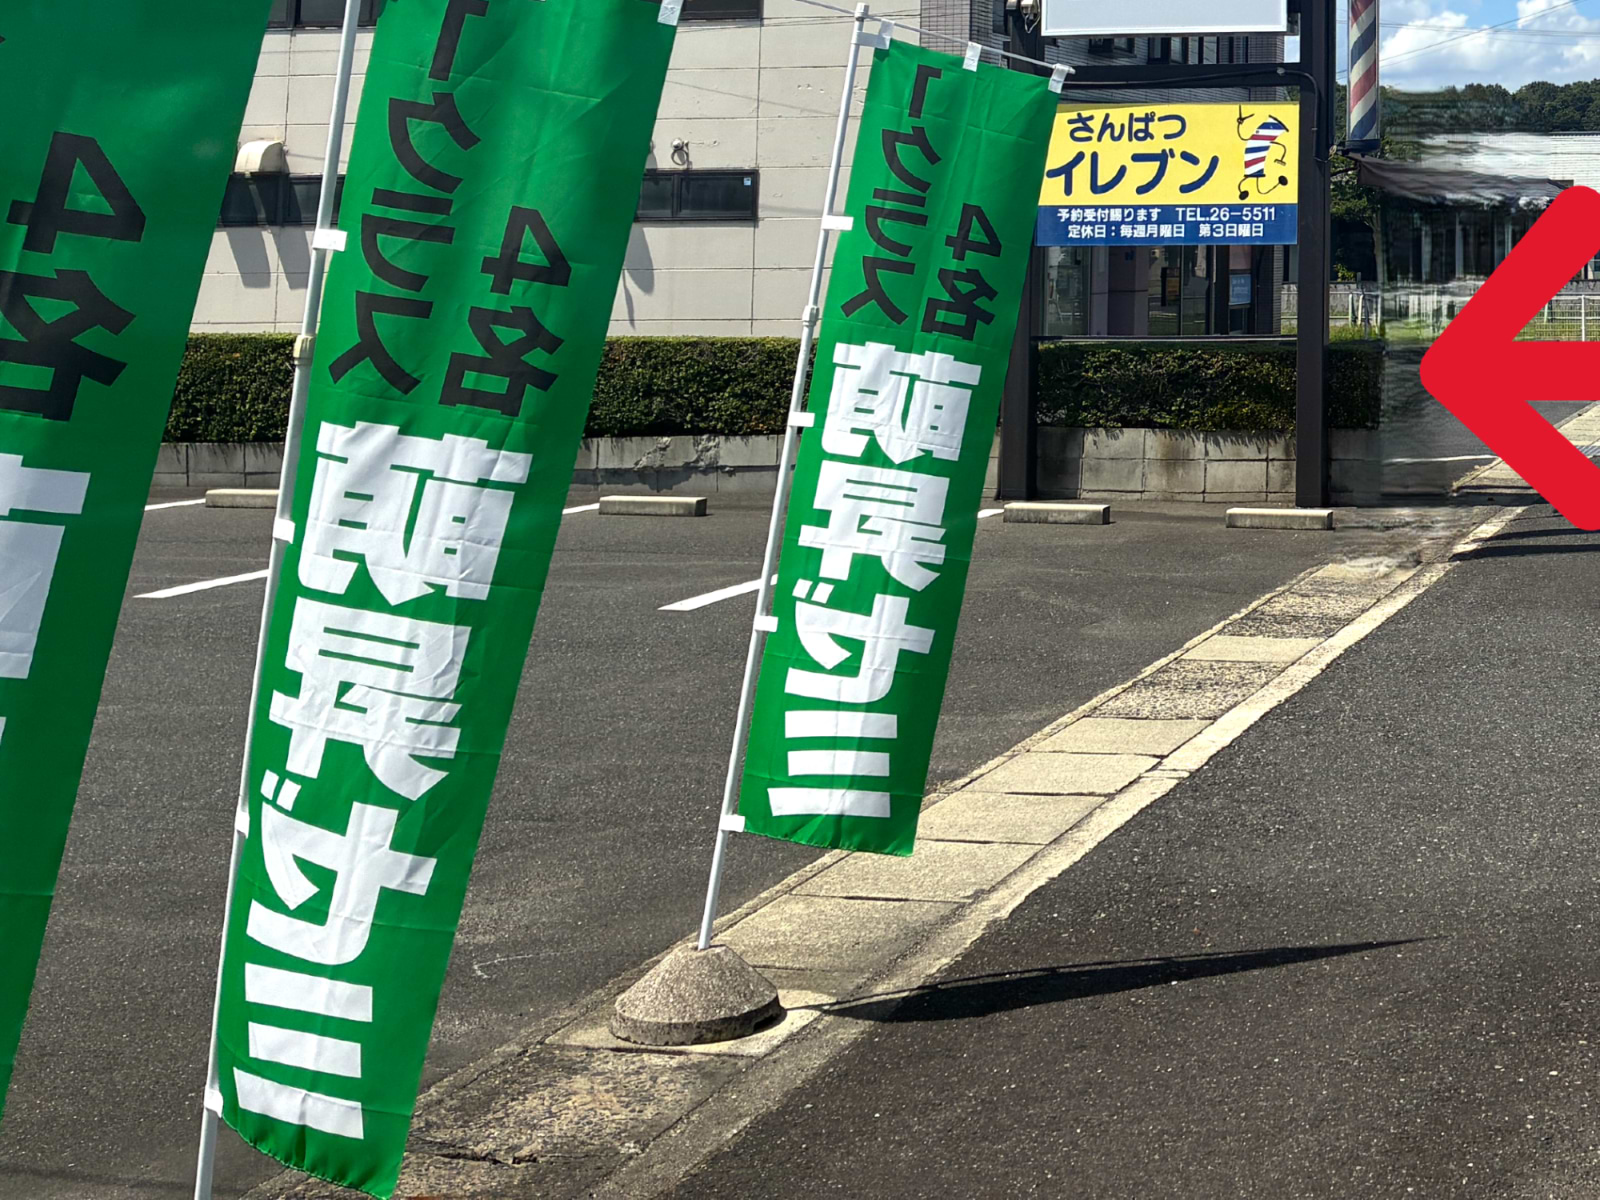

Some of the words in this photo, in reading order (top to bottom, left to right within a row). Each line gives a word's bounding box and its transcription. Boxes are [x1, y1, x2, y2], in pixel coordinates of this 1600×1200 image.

[1067, 111, 1187, 142] さんぱつ
[1046, 149, 1219, 196] イレブン
[1057, 207, 1162, 223] 予約受付賜ります
[1198, 223, 1264, 238] 第3日曜日
